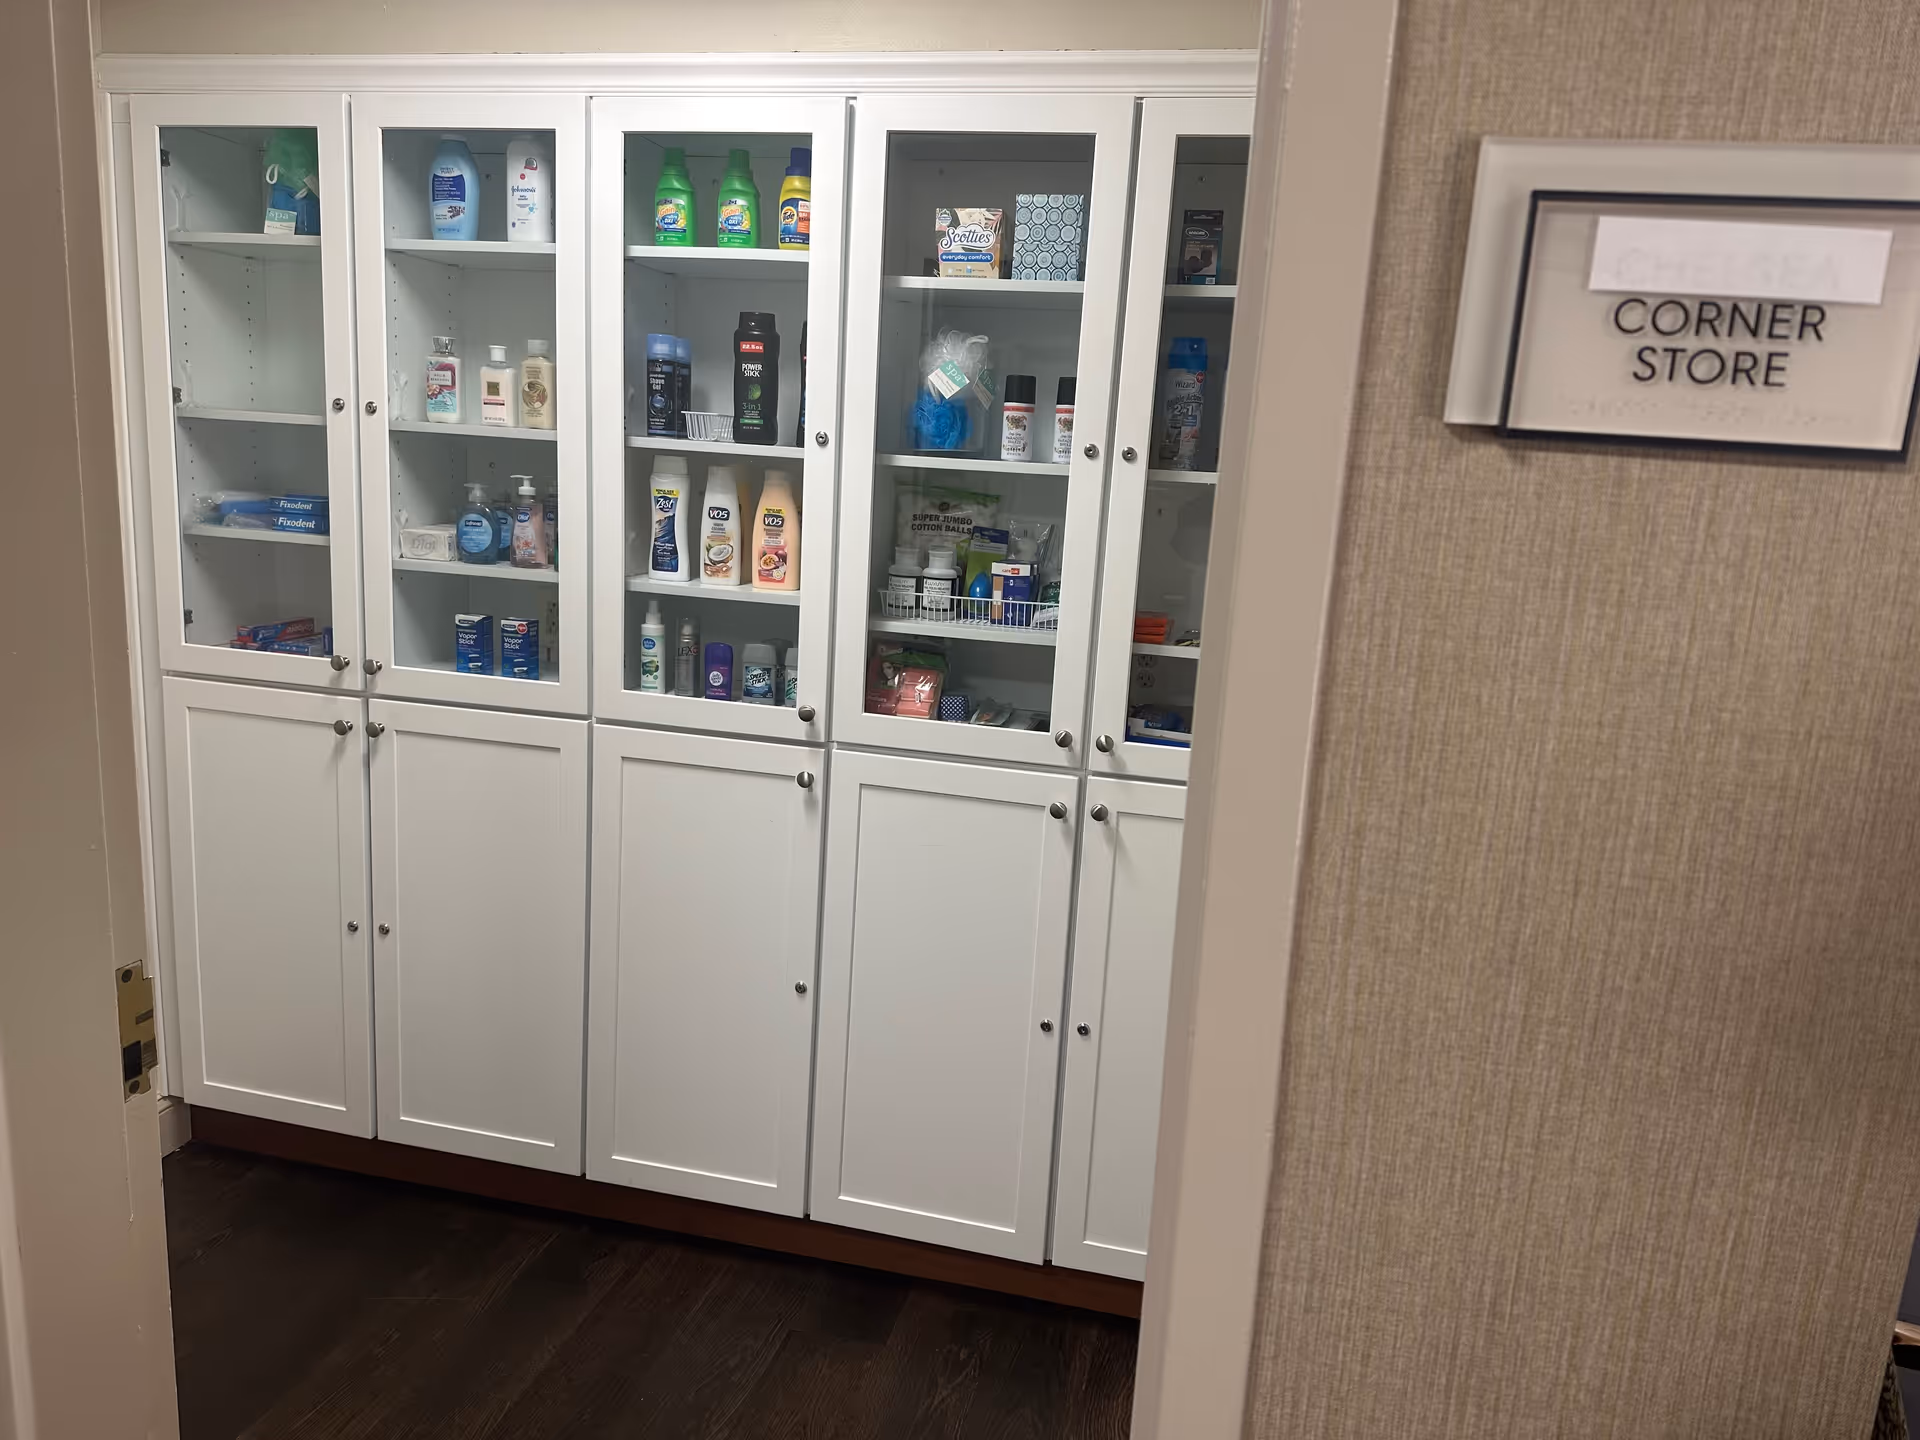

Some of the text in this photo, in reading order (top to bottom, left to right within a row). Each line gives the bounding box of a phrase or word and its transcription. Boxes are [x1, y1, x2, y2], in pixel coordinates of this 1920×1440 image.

[268, 210, 289, 221] spa
[940, 227, 990, 249] Scotties
[1613, 298, 1827, 342] CORNER
[742, 363, 762, 371] POWER
[945, 364, 962, 381] spa
[1632, 346, 1790, 388] STORE
[279, 500, 313, 510] Fixodent
[656, 498, 674, 508] Zest
[710, 510, 728, 518] VO5
[912, 513, 973, 526] SUPER JUMBO
[278, 517, 316, 529] Fixodent
[764, 517, 782, 525] VO5
[911, 524, 972, 535] COTTON BALLS
